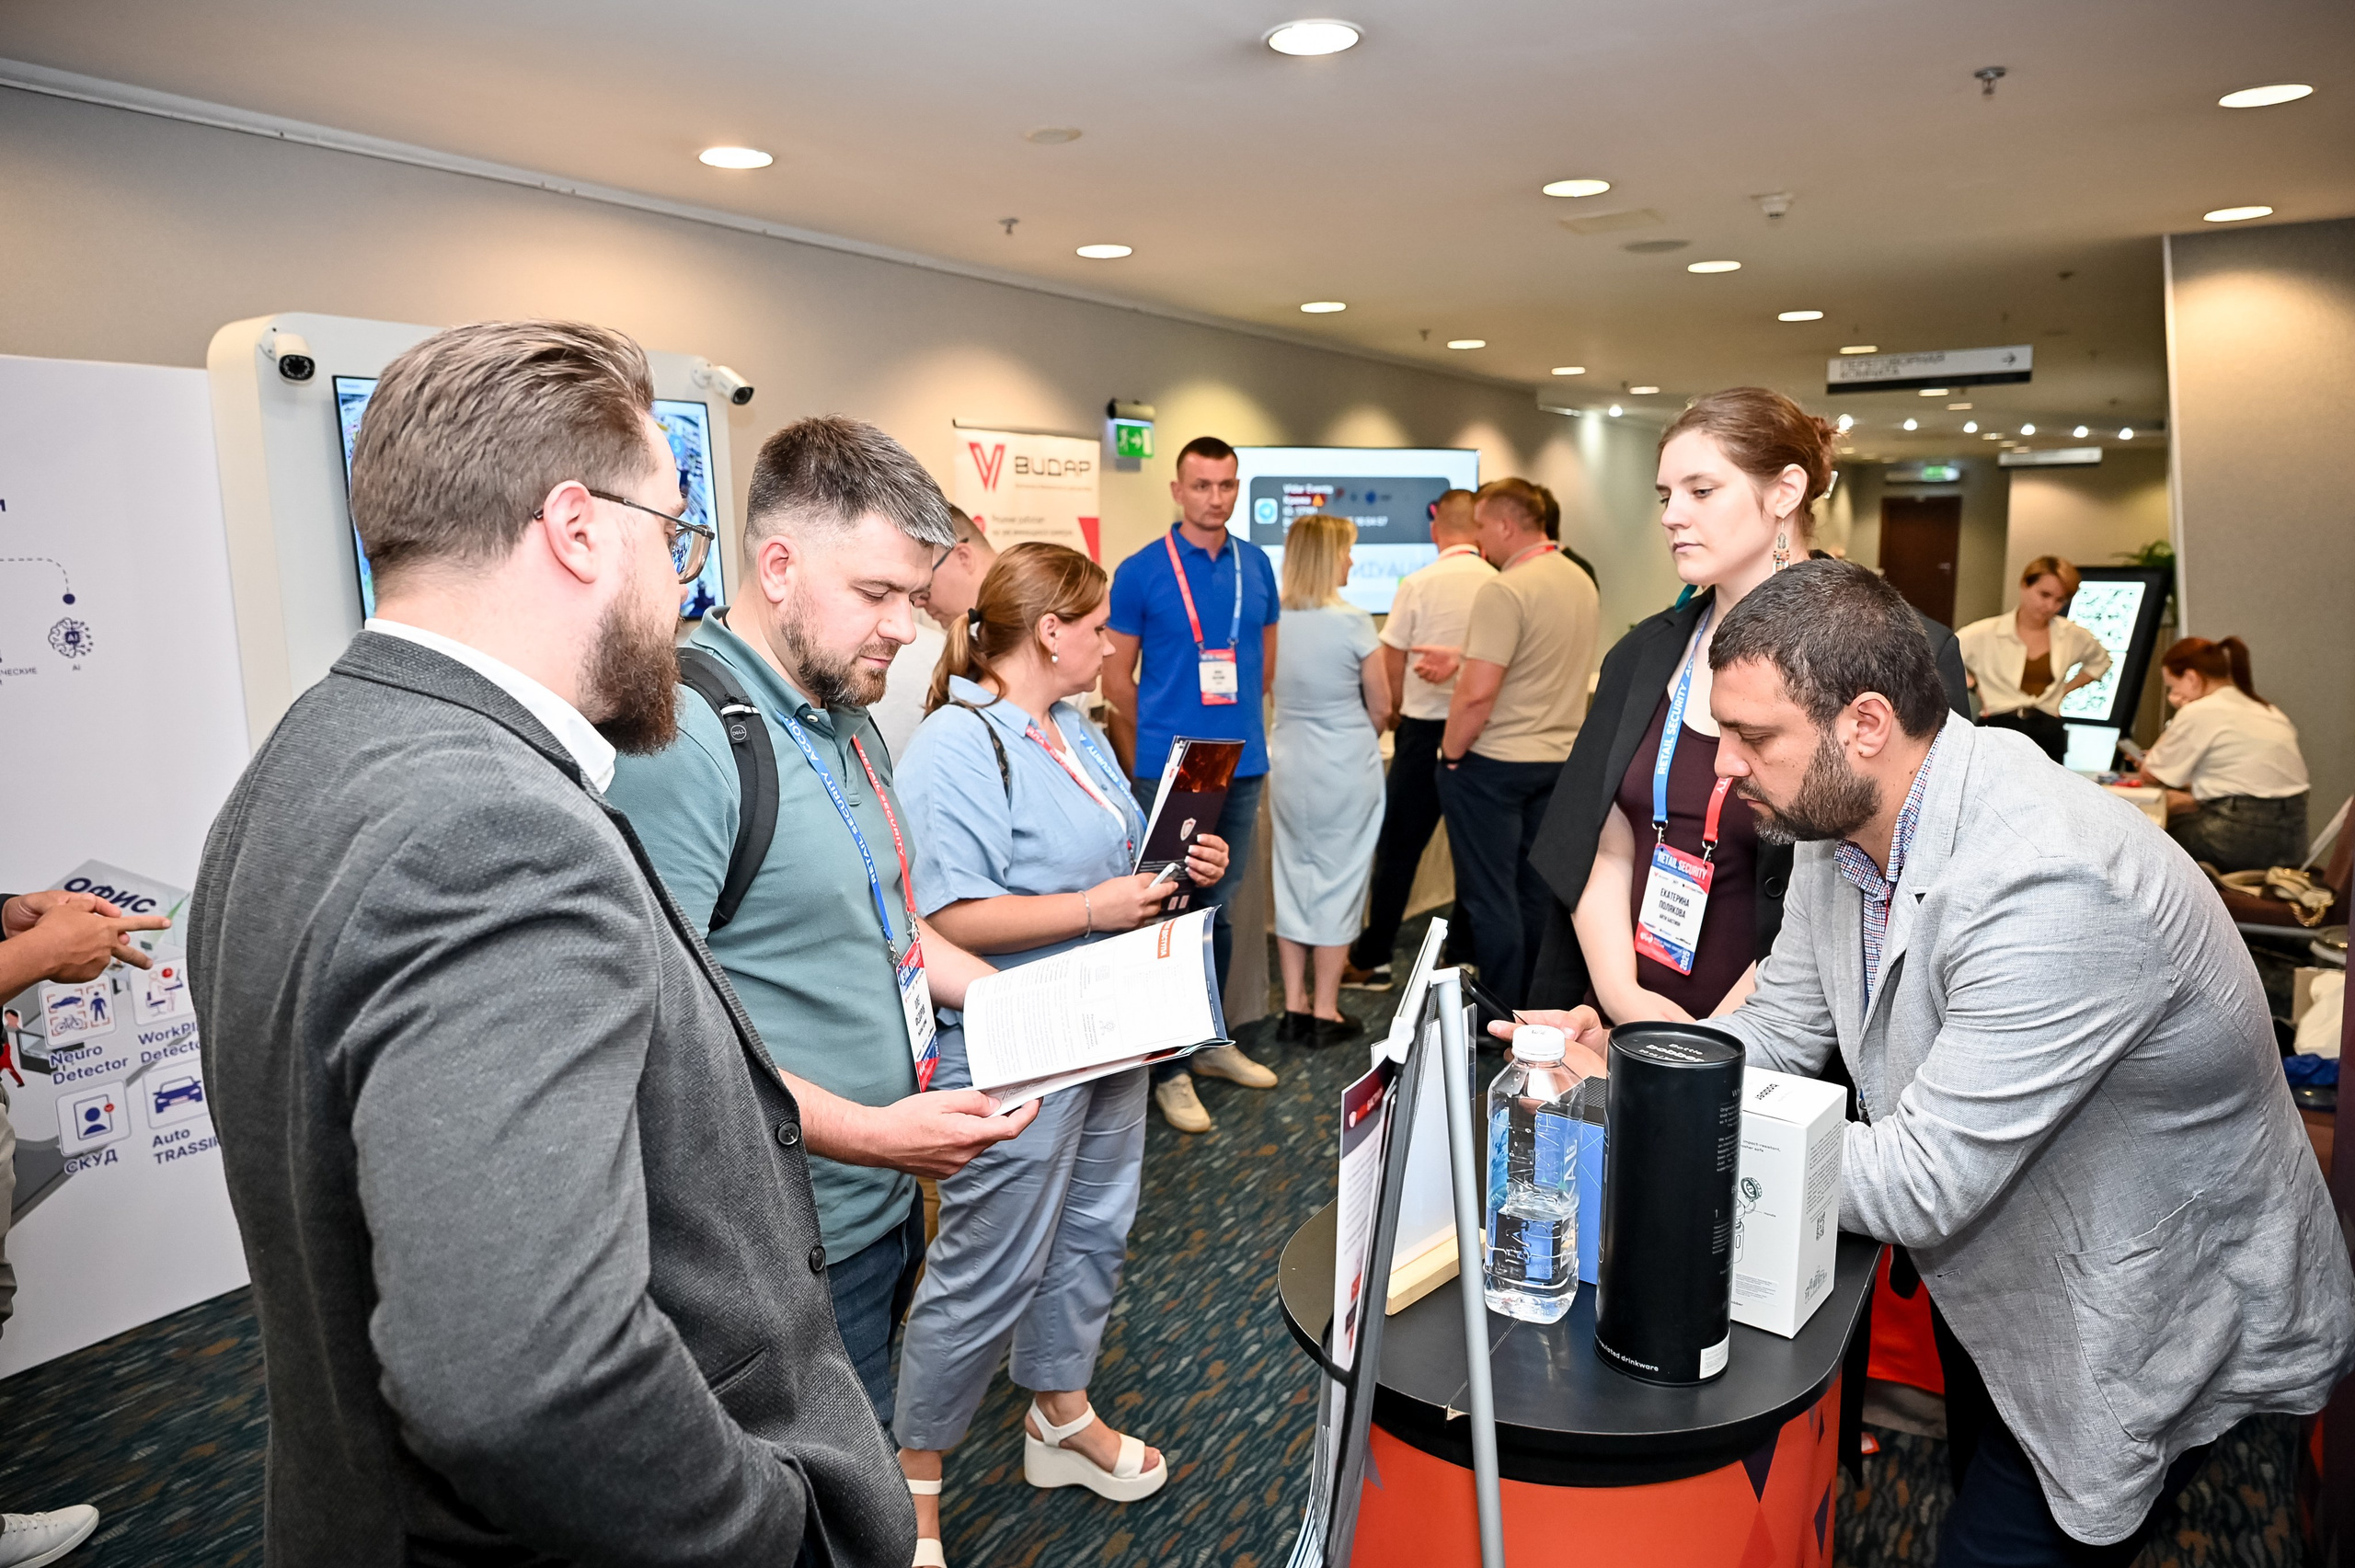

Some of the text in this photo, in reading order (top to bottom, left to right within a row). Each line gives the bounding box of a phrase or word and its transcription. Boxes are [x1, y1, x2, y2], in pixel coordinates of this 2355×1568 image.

[732, 728, 745, 737] DELL
[1657, 682, 1688, 775] RETAIL SECURITY
[1086, 744, 1120, 784] SECURITY
[821, 771, 859, 836] SECURITY
[859, 749, 905, 856] RETAIL SECURITY
[858, 834, 878, 885] RETAIL
[1657, 851, 1679, 870] RETAIL
[1677, 860, 1708, 881] SECURITY
[63, 877, 156, 913] ОФИС
[1660, 887, 1690, 908] ЕКАТЕРИНА
[1659, 899, 1687, 920] ПОЛЯКОВА
[138, 1022, 198, 1045] WorkPl
[50, 1045, 103, 1067] Neuro
[1646, 1044, 1705, 1062] bobber
[1669, 1043, 1703, 1055] Bottle
[53, 1058, 129, 1085] Detector
[153, 1128, 190, 1148] Auto
[64, 1149, 120, 1175] СКУД
[1621, 1355, 1660, 1372] drinkware
